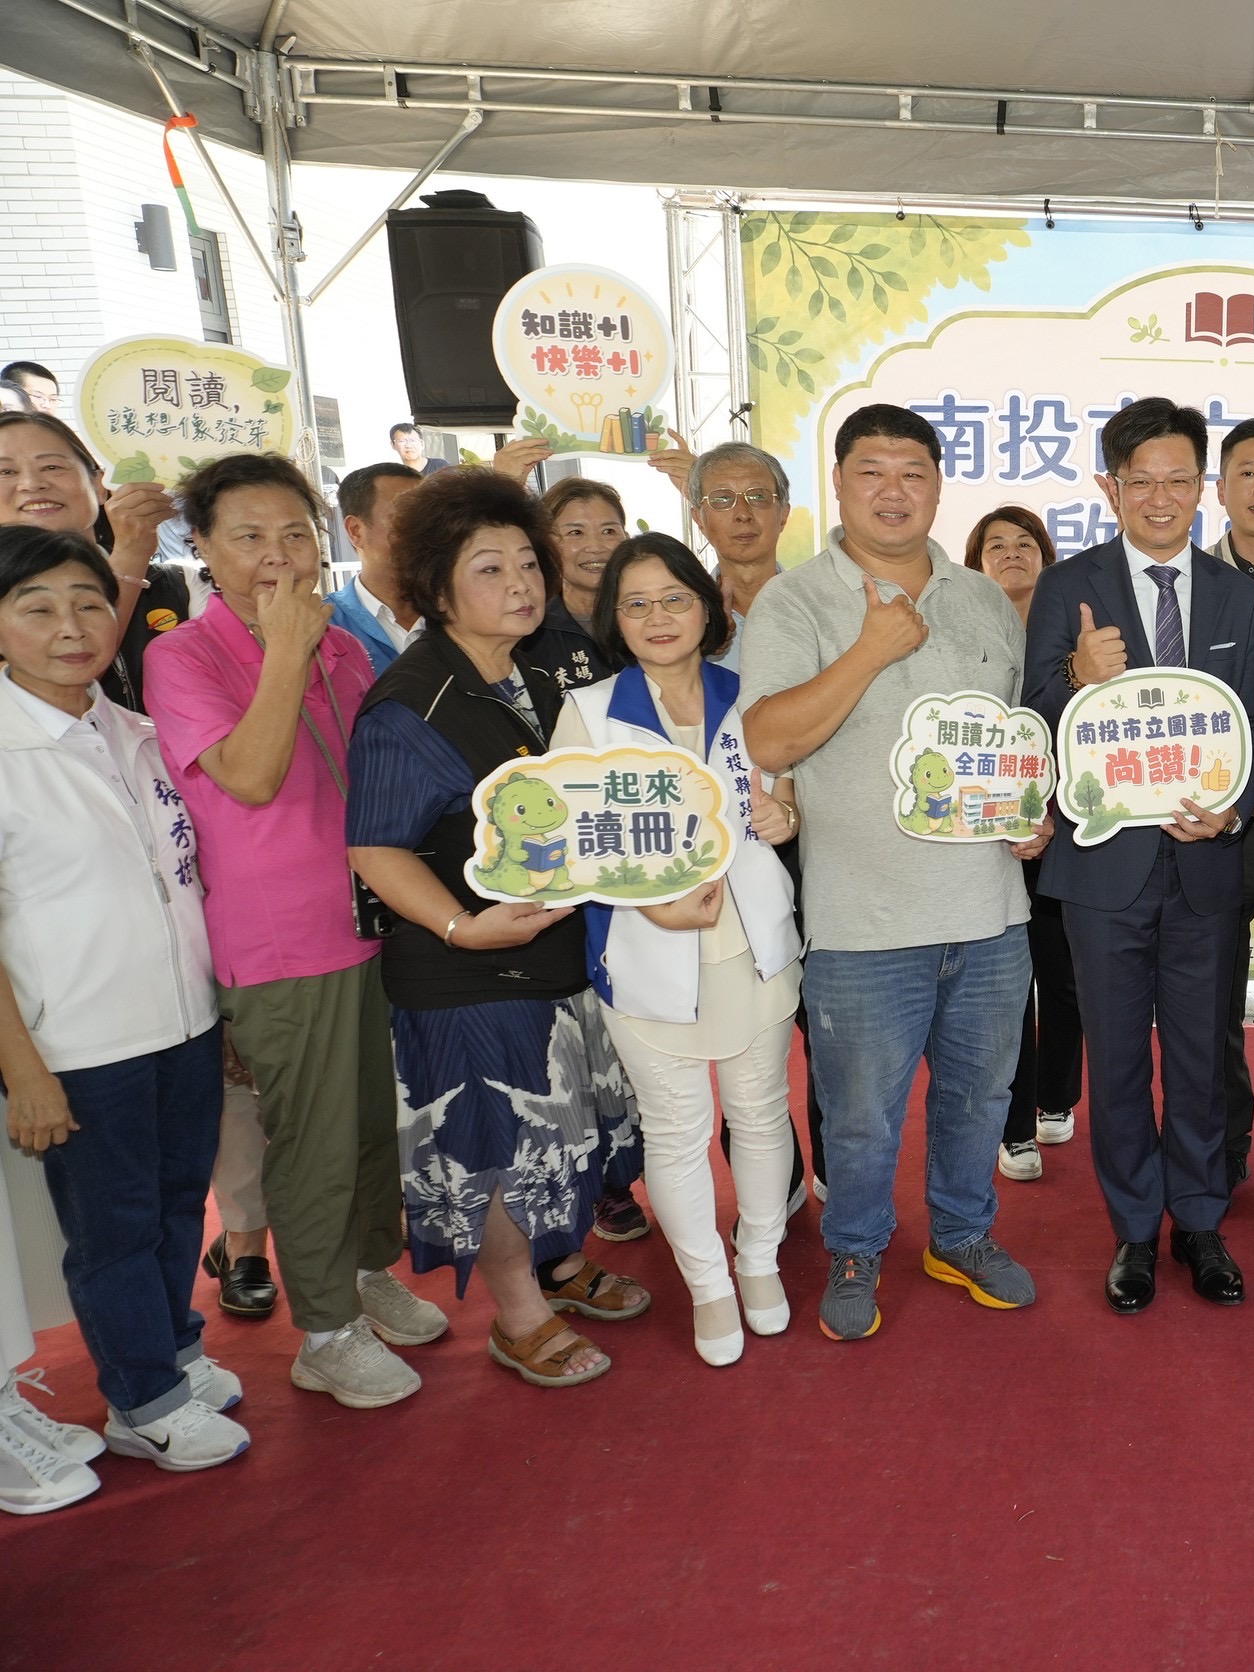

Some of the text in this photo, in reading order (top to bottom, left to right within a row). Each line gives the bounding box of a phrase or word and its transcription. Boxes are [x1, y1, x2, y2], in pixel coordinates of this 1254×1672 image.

[521, 309, 630, 340] 知識+1
[531, 345, 639, 377] 快樂+1
[107, 406, 268, 448] 讓想像發芽
[572, 650, 593, 680] 媽媽
[938, 720, 1017, 748] 閱讀力，
[1076, 710, 1231, 745] 南投市立圖書館
[955, 752, 1047, 779] 全面開機!
[1105, 743, 1200, 787] 尚讚!
[563, 769, 682, 806] 一起來
[575, 810, 698, 857] 讀冊!
